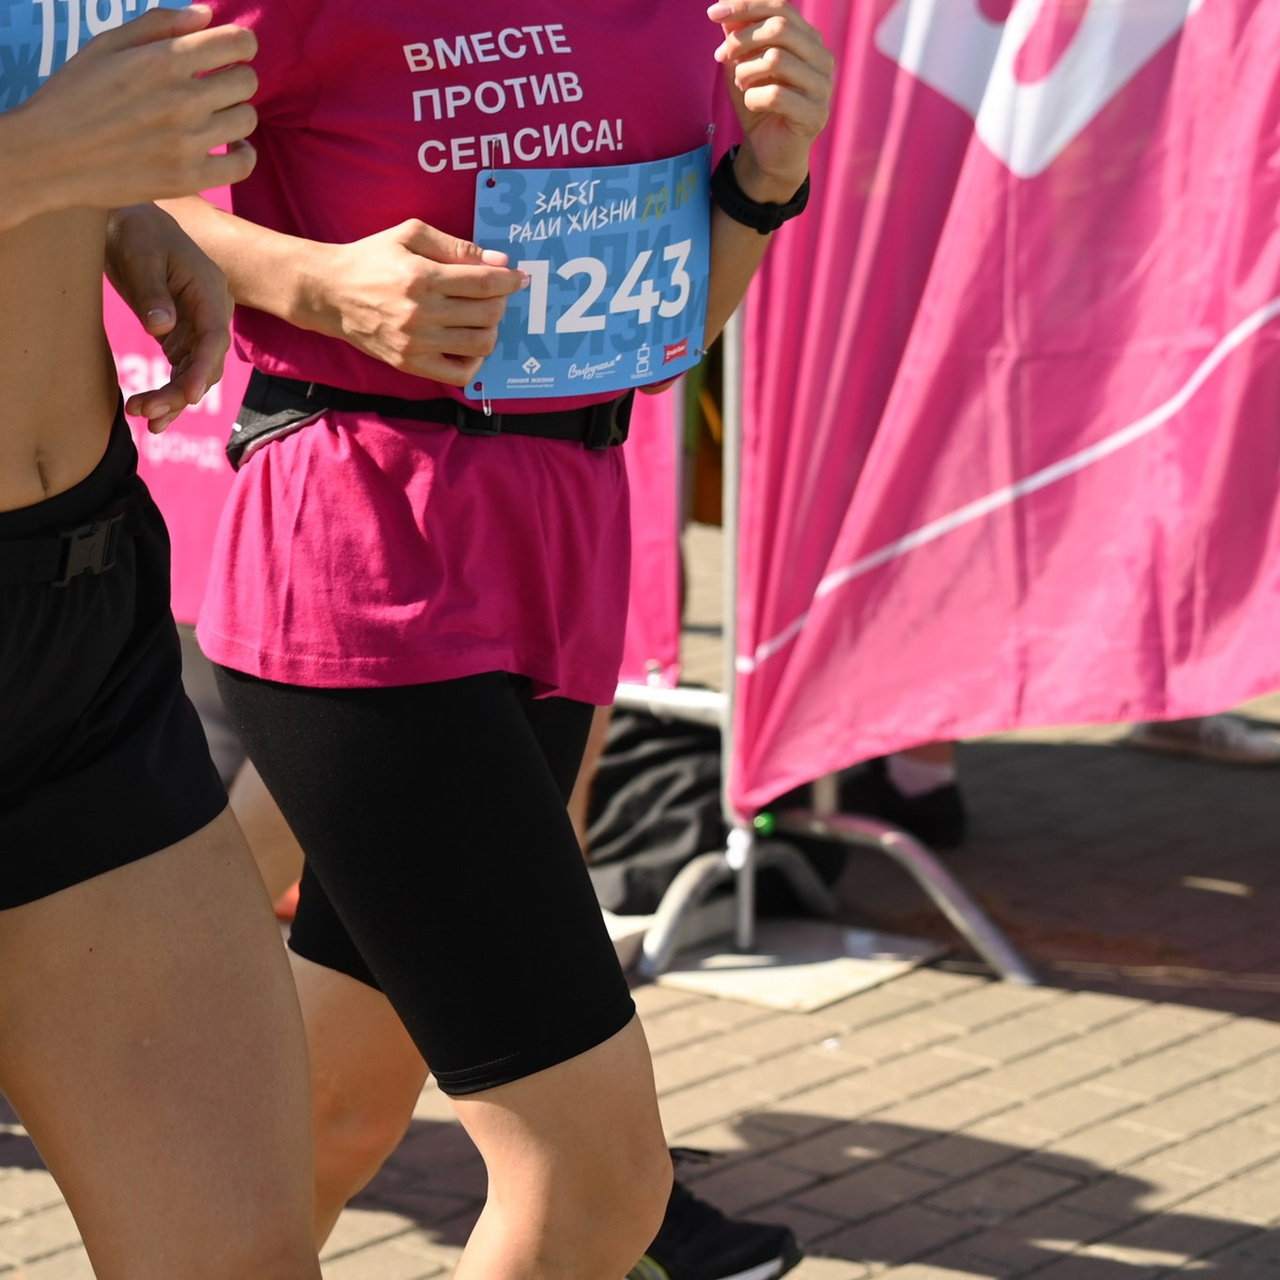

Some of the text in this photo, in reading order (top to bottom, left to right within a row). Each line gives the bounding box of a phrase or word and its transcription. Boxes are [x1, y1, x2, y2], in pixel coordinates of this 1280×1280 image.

[403, 24, 572, 73] ВМЕСТЕ
[412, 71, 584, 122] ПРОТИВ
[417, 119, 625, 174] СЕПСИСА!
[509, 219, 561, 243] РАДИ
[567, 196, 637, 232] ЖИЗНИ
[641, 193, 667, 222] 10
[534, 179, 600, 213] ЗАБЕГ
[518, 239, 692, 336] 1243
